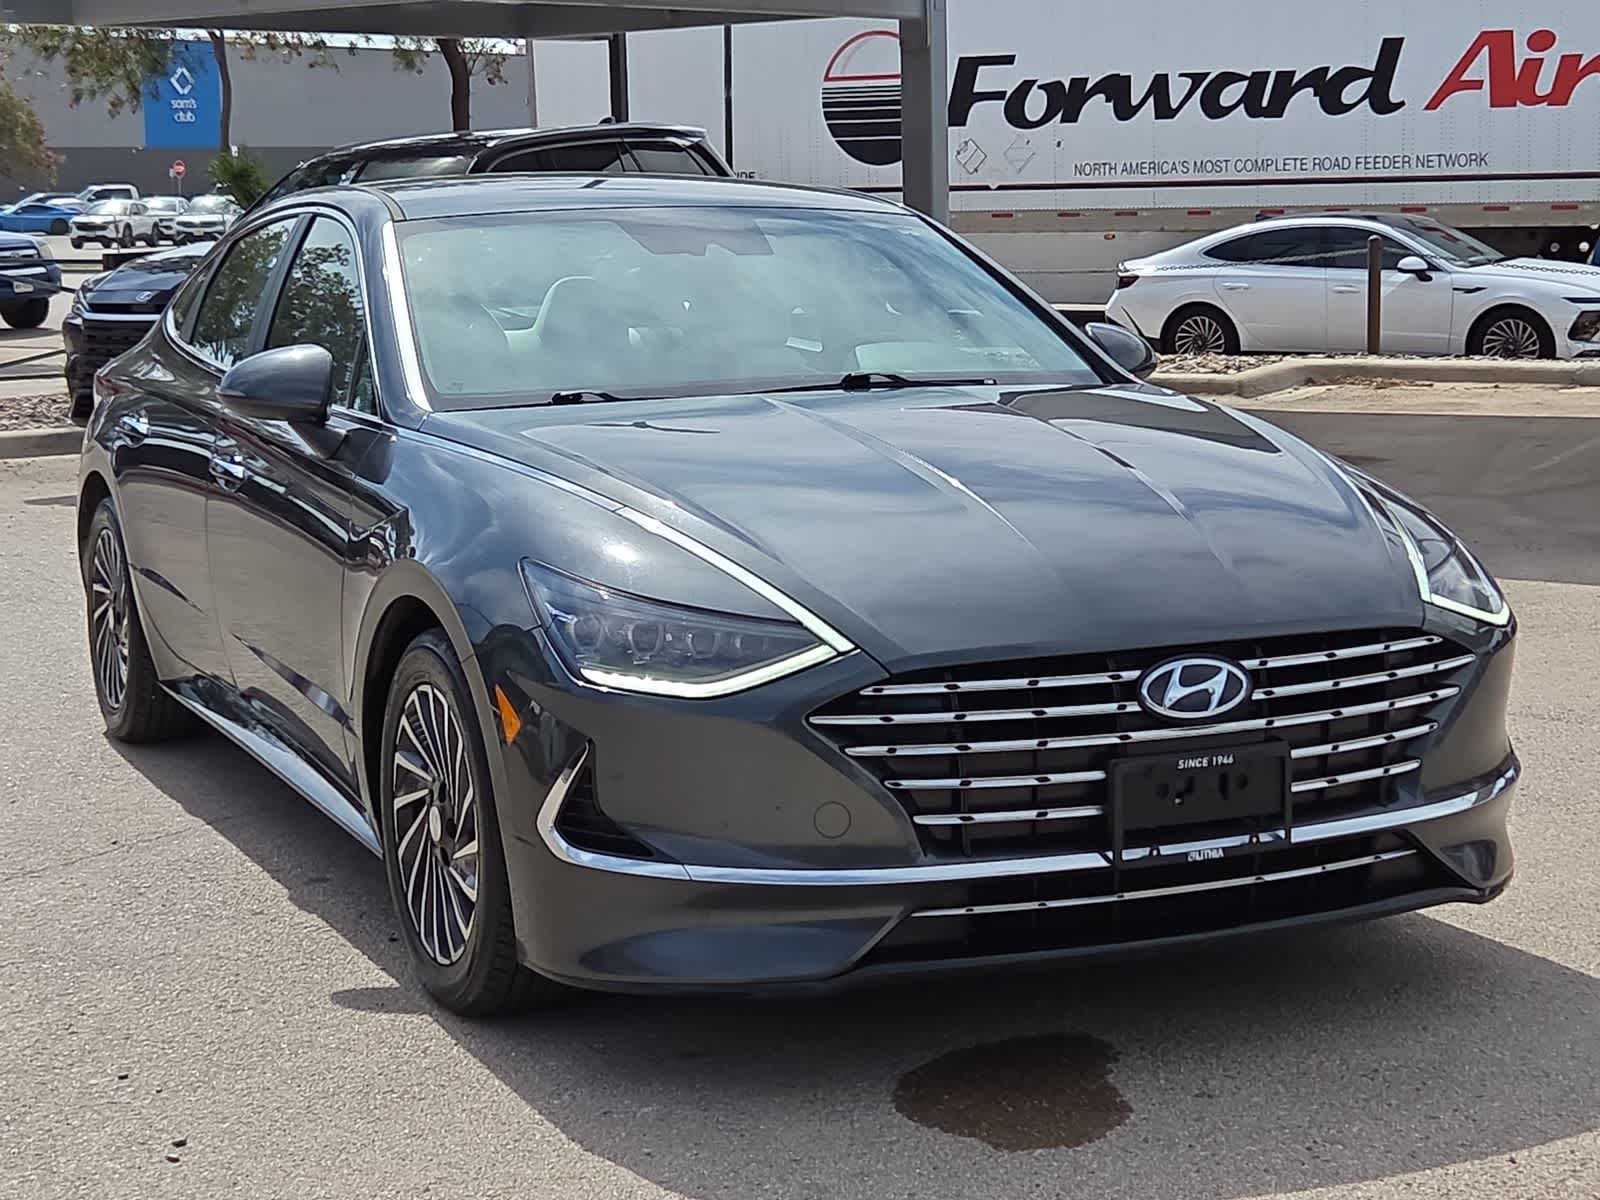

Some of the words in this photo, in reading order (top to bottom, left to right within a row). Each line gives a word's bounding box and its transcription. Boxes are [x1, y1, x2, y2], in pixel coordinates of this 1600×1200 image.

[947, 37, 1406, 130] Forward
[1423, 29, 1600, 111] Air
[174, 111, 196, 122] club
[1074, 162, 1117, 176] NORTH
[1120, 160, 1190, 176] AMERICA'S
[1193, 159, 1230, 174] MOST
[1234, 157, 1308, 173] COMPLETE
[1312, 156, 1351, 171] ROAD
[1355, 154, 1411, 170] FEEDER
[1415, 152, 1489, 169] NETWORK
[1177, 756, 1209, 769] SINCE
[1212, 753, 1234, 766] 1946
